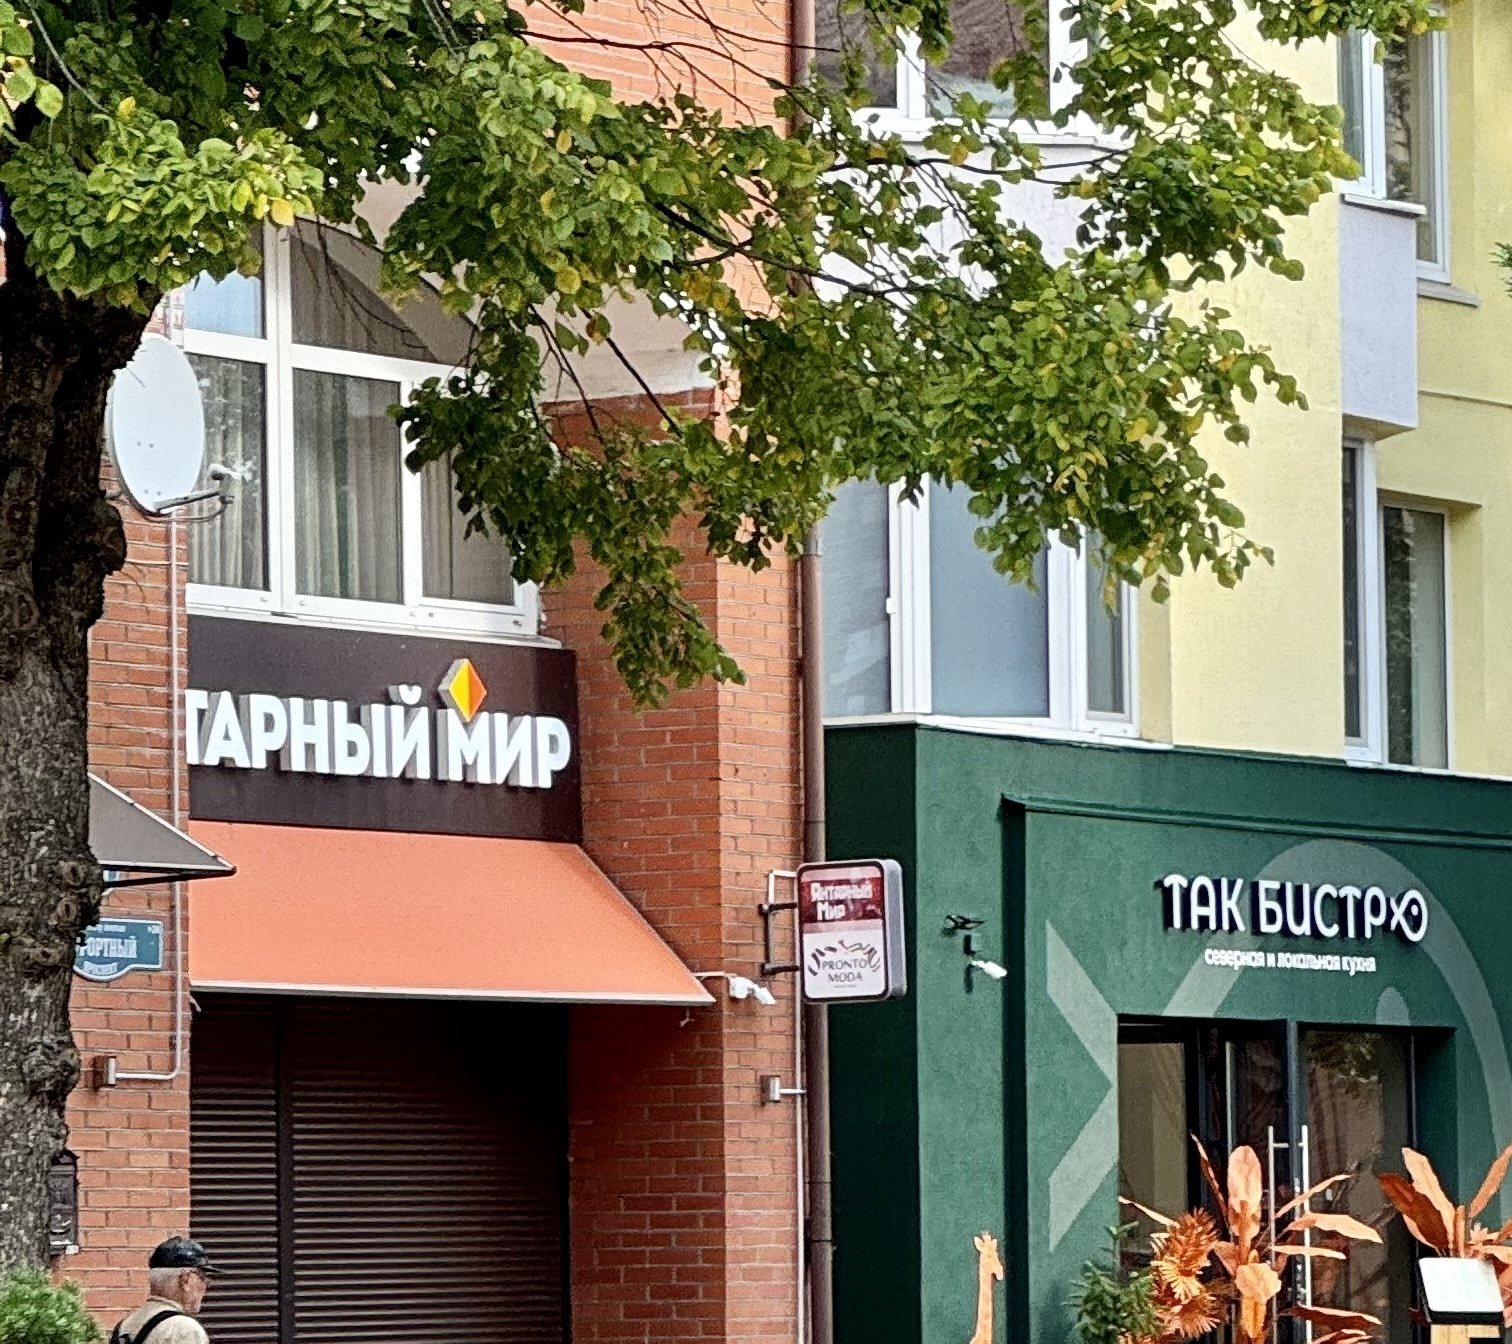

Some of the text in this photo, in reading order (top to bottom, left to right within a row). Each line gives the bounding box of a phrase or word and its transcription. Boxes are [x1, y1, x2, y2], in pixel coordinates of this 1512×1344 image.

[440, 707, 572, 789] МИР
[1162, 874, 1246, 932] ТАК
[821, 958, 868, 971] PRONTO
[828, 971, 863, 984] MODA
